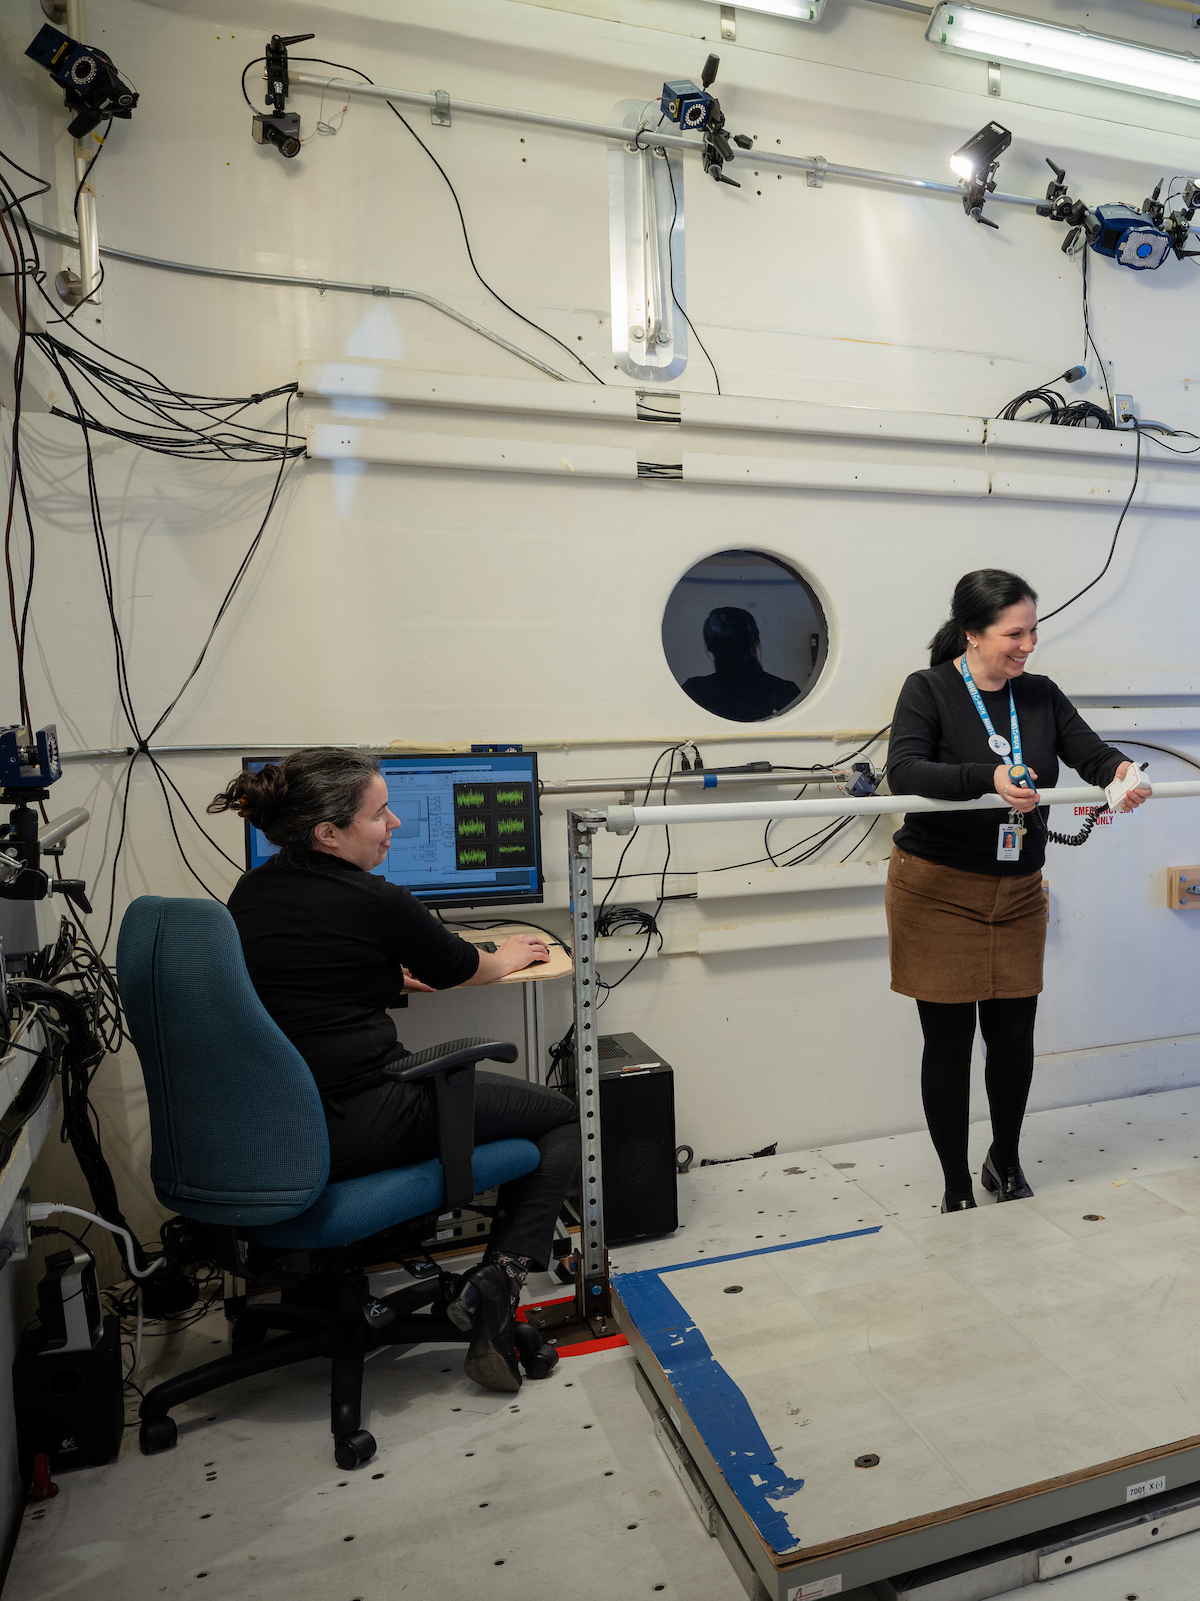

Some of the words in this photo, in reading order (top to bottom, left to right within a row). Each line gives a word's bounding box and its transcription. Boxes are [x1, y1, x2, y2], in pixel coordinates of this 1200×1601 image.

[962, 663, 971, 678] kite
[966, 680, 979, 697] UHN
[976, 700, 987, 715] kite
[982, 717, 994, 733] UHN
[1010, 714, 1019, 730] UHN
[1012, 734, 1020, 750] kite
[1095, 815, 1114, 826] ONLY
[1130, 1485, 1146, 1496] 7001
[1149, 1482, 1155, 1490] X
